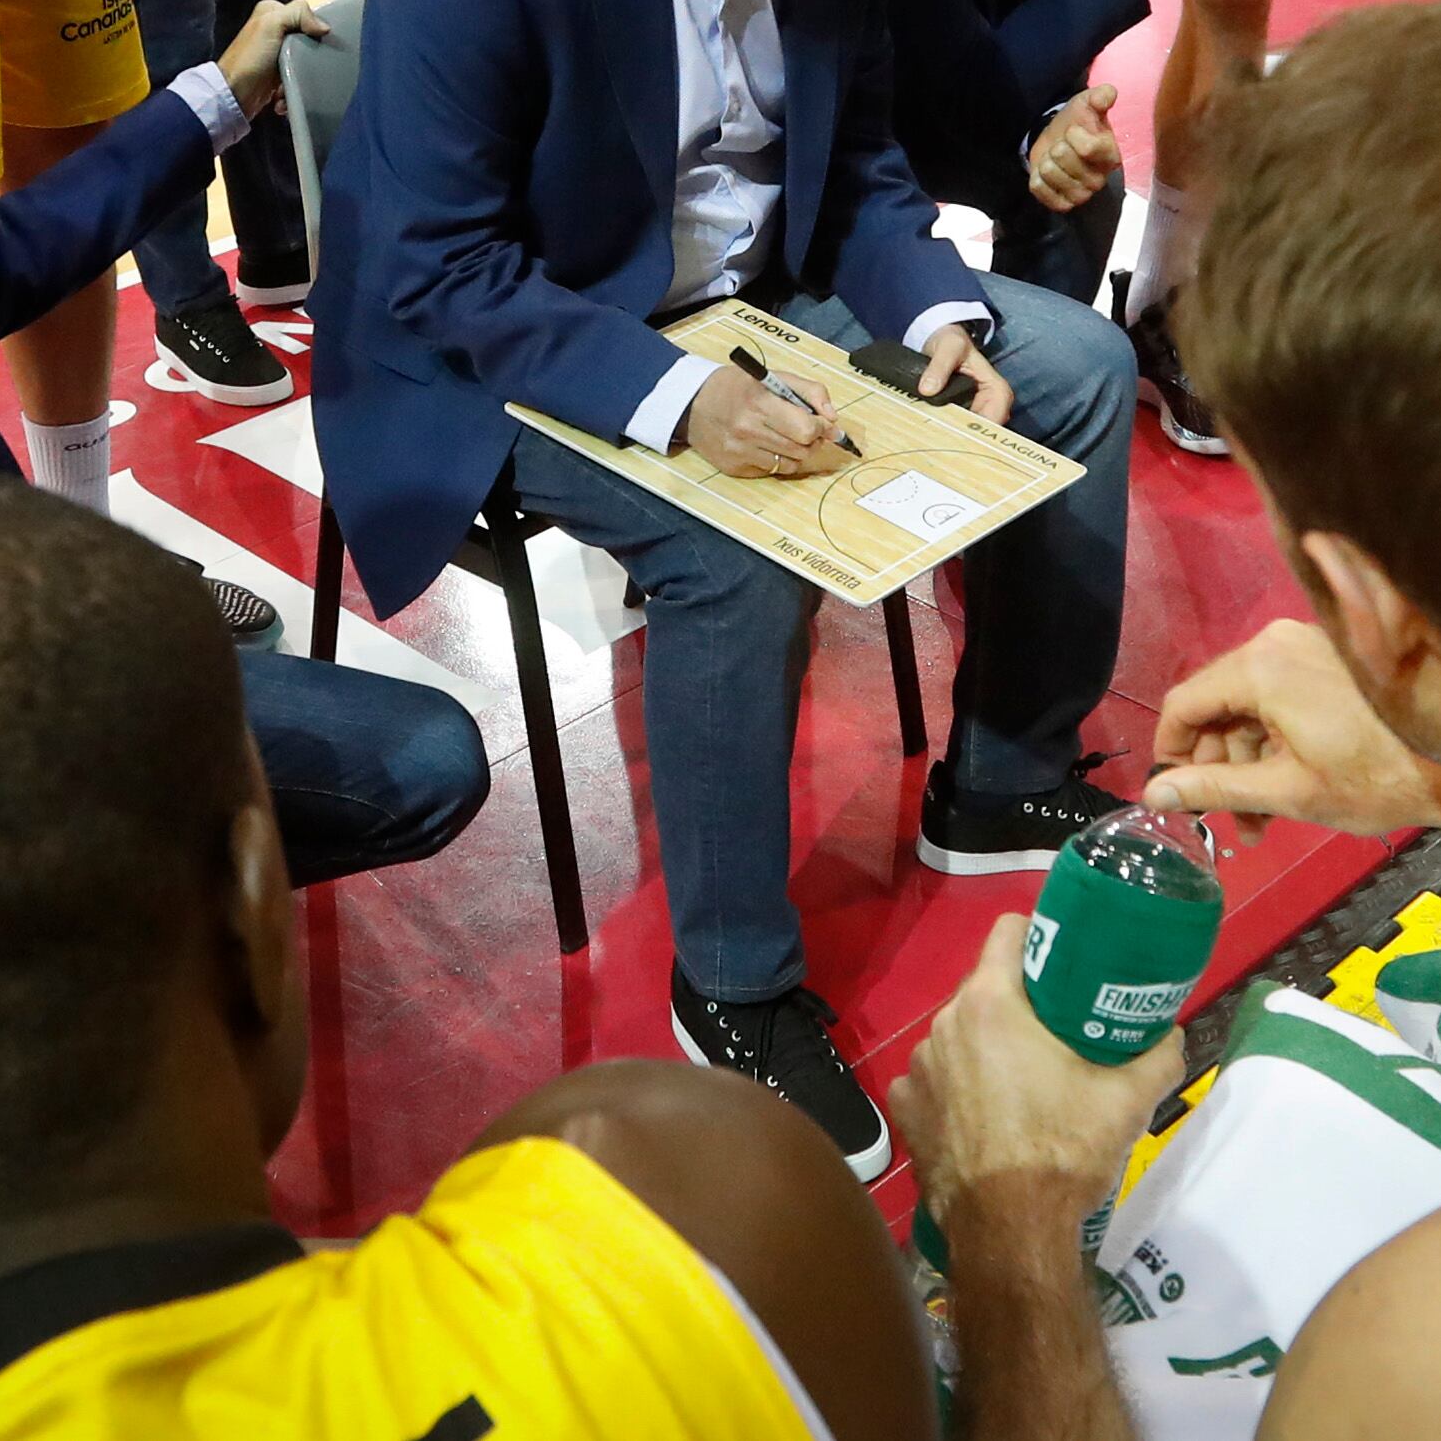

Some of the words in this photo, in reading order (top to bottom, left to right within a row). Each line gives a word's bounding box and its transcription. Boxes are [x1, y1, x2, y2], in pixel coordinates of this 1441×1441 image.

[732, 306, 801, 345] Lenovo
[979, 427, 998, 443] LA
[999, 436, 1059, 471] LAGUNA
[801, 551, 862, 591] Vidorreta
